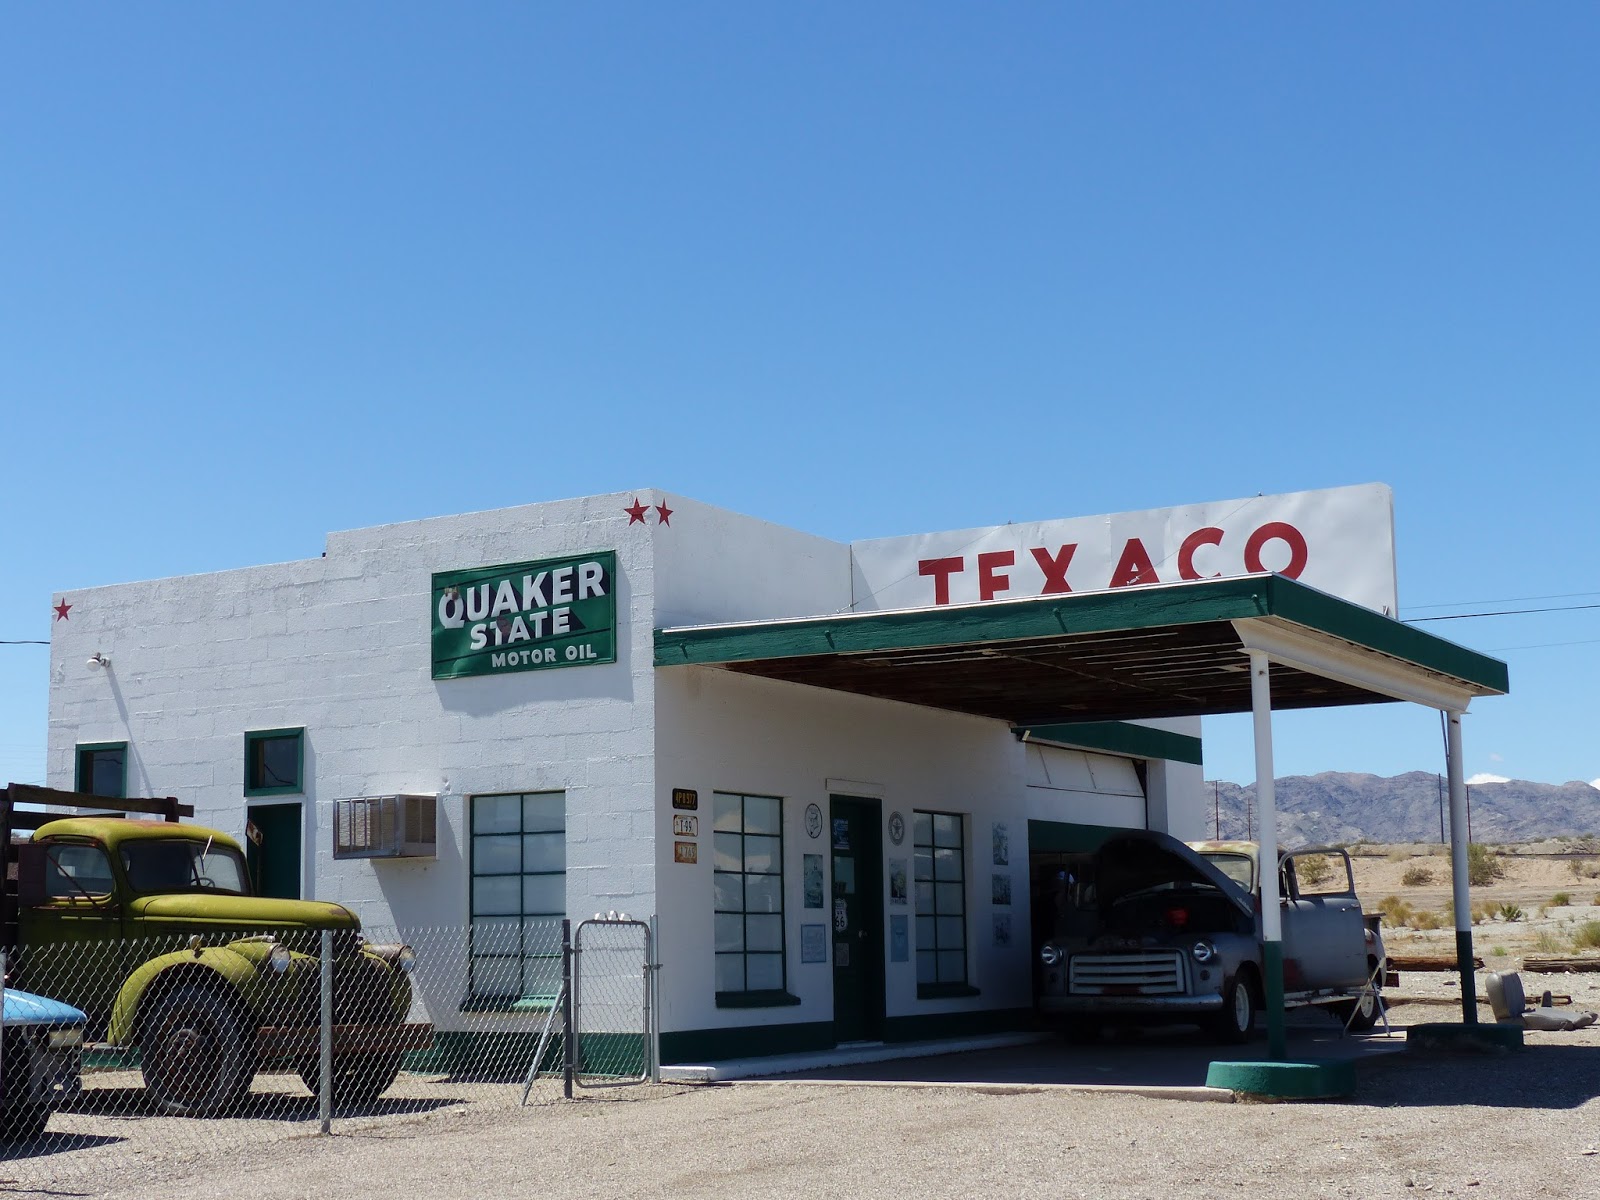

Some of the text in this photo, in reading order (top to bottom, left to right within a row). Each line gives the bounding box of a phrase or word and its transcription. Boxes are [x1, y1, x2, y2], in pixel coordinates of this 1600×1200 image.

[438, 561, 606, 630] QUAKER
[470, 606, 571, 651] STATE
[491, 643, 598, 668] MOTOR OIL
[835, 916, 845, 927] 66
